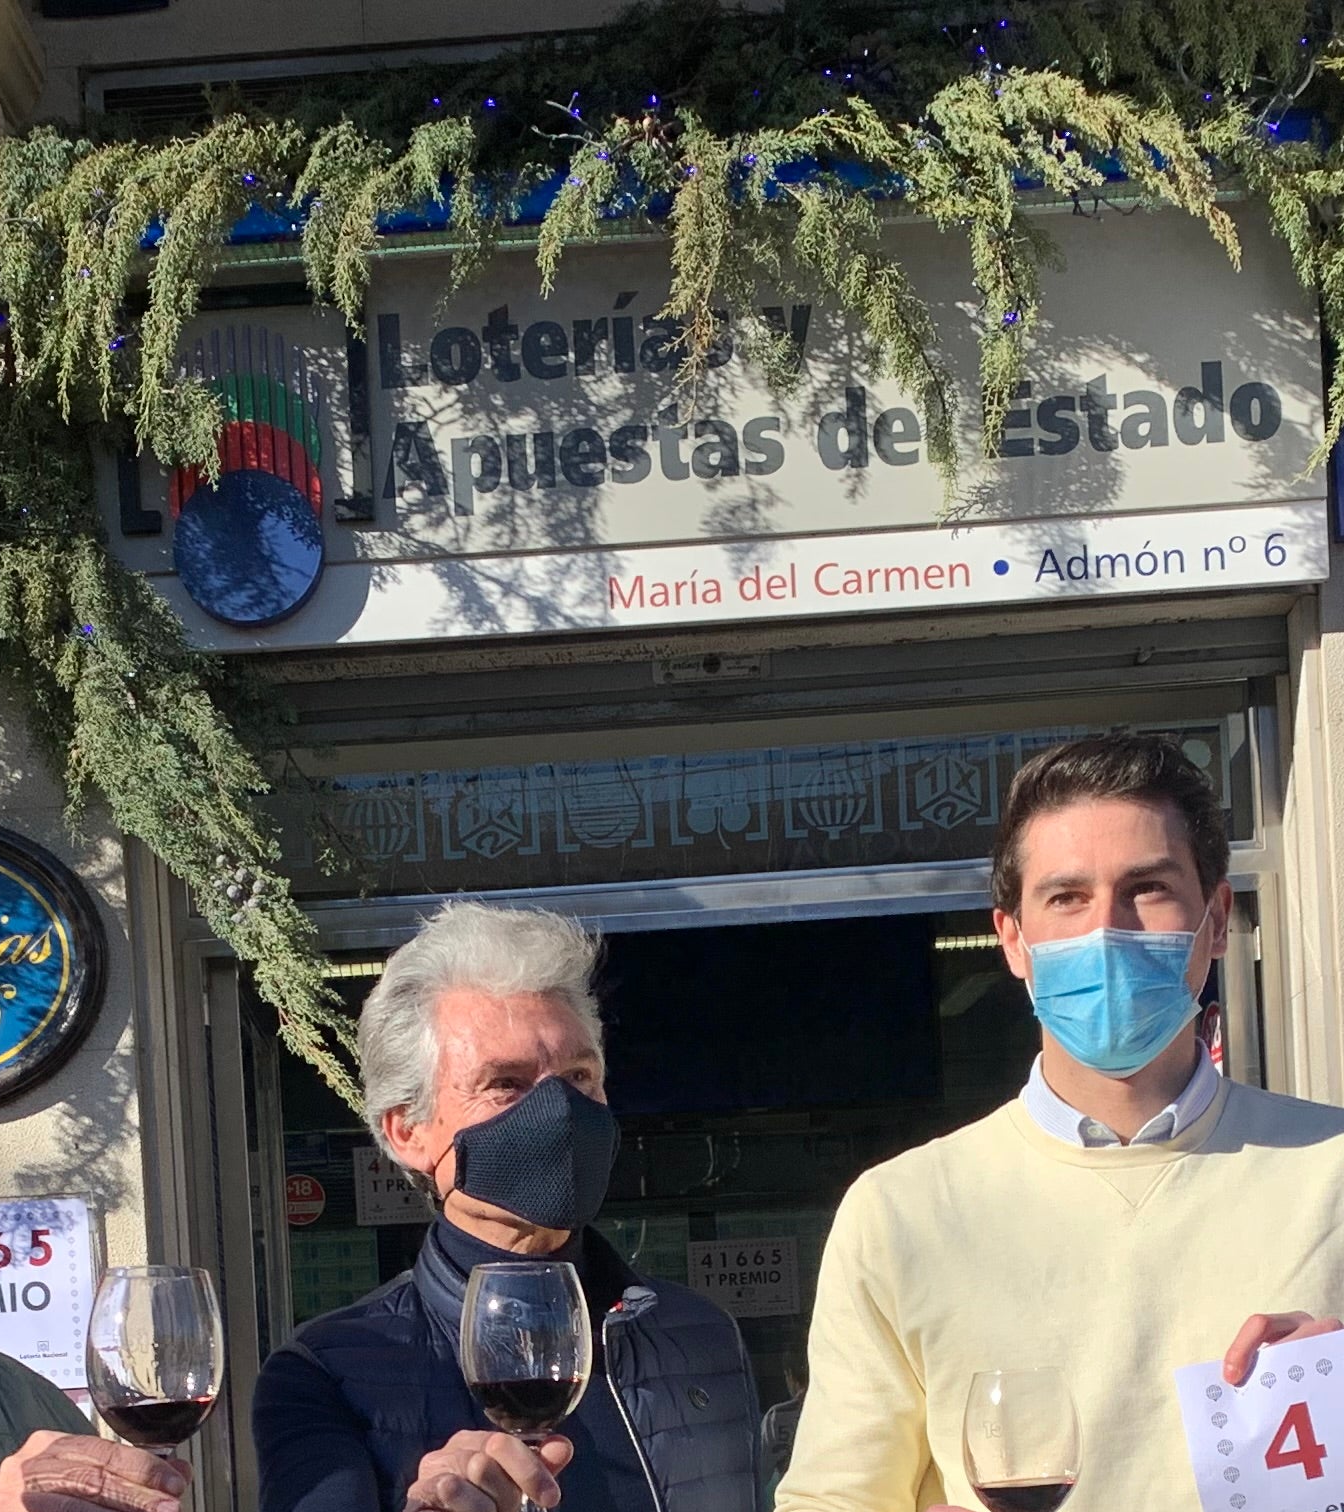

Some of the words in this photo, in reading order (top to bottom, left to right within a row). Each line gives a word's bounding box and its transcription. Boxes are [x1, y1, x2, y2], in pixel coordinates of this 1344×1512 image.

[381, 403, 786, 517] Apuestas
[816, 386, 948, 470] de
[982, 360, 1283, 458] Estado
[608, 569, 722, 610] María
[738, 562, 798, 601] del
[814, 562, 971, 597] Carmen
[1035, 540, 1186, 583] Admón
[1264, 532, 1288, 567] 6
[701, 1248, 783, 1269] 41665
[718, 1269, 783, 1287] PREMIO
